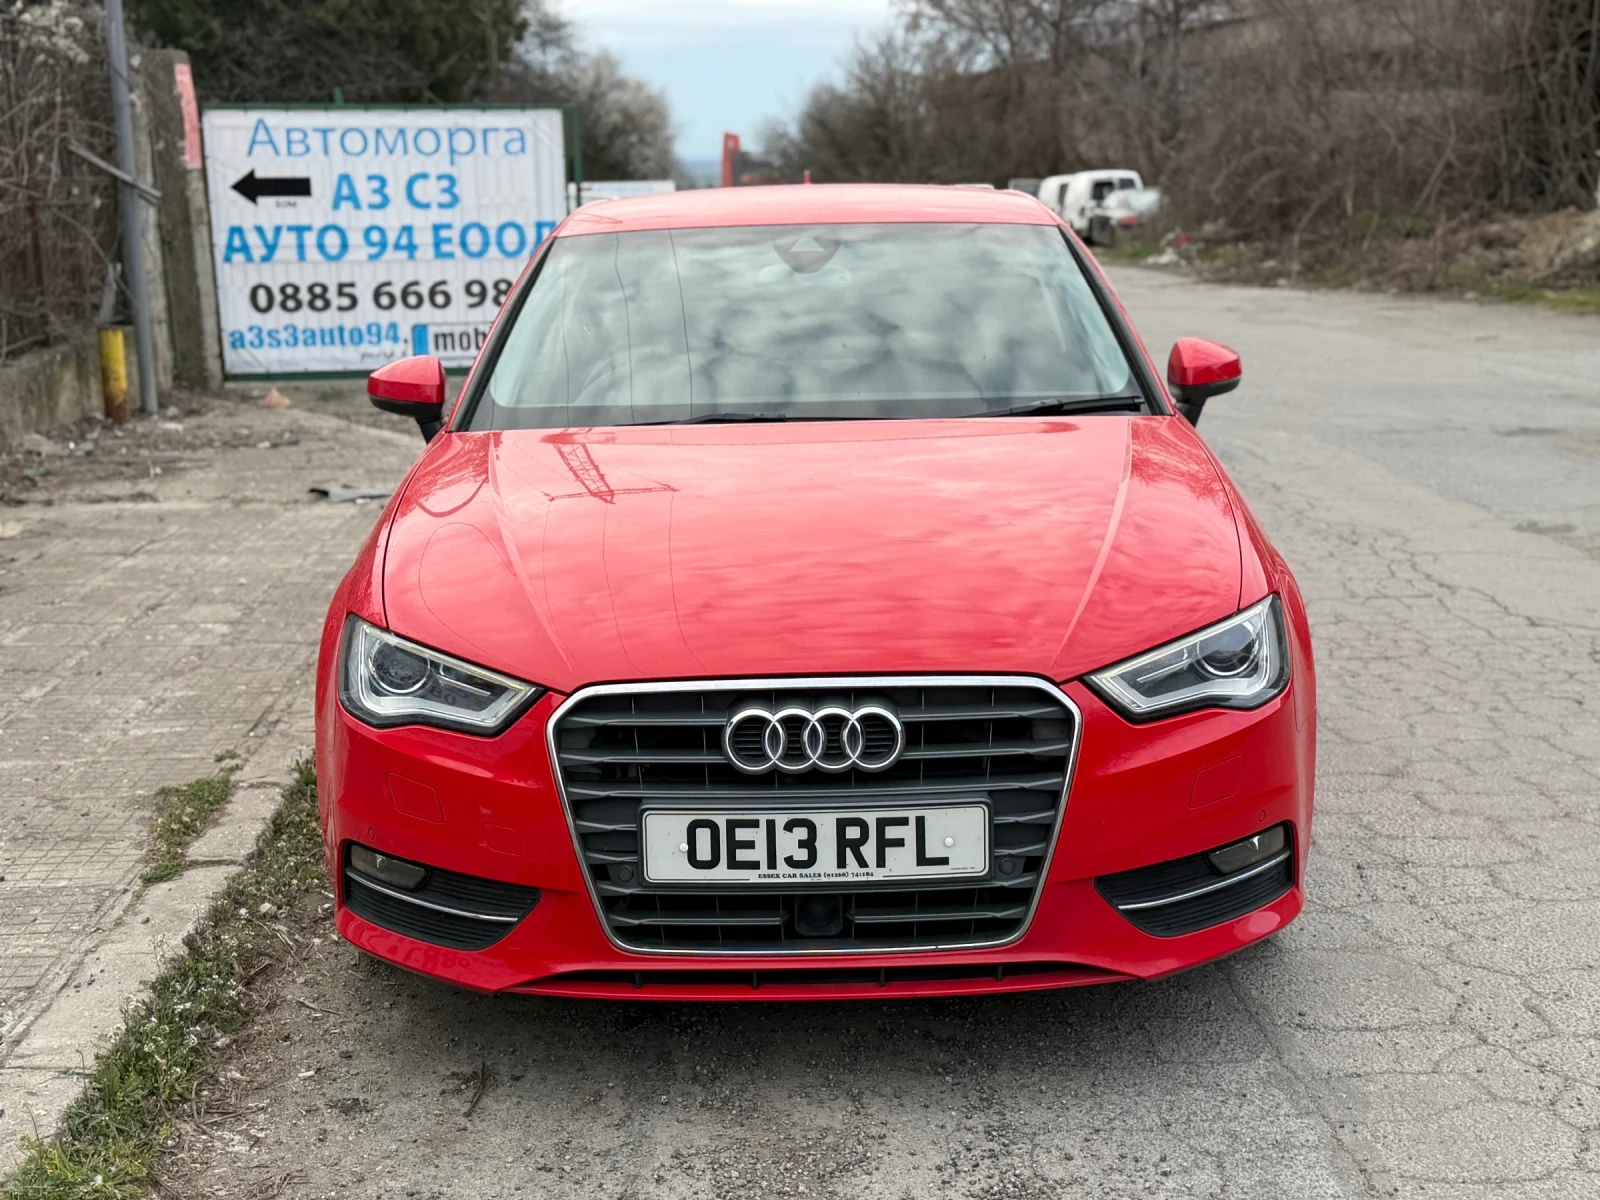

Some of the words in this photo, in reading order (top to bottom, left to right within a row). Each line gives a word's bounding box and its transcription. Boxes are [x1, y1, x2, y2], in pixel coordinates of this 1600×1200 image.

[246, 117, 526, 167] Автоморга
[223, 224, 349, 263] АУТО
[363, 224, 418, 262] 94
[250, 282, 359, 313] 0885
[373, 279, 452, 311] 666
[433, 325, 493, 351] mob
[686, 818, 818, 871] OE13
[835, 815, 950, 869] RFL
